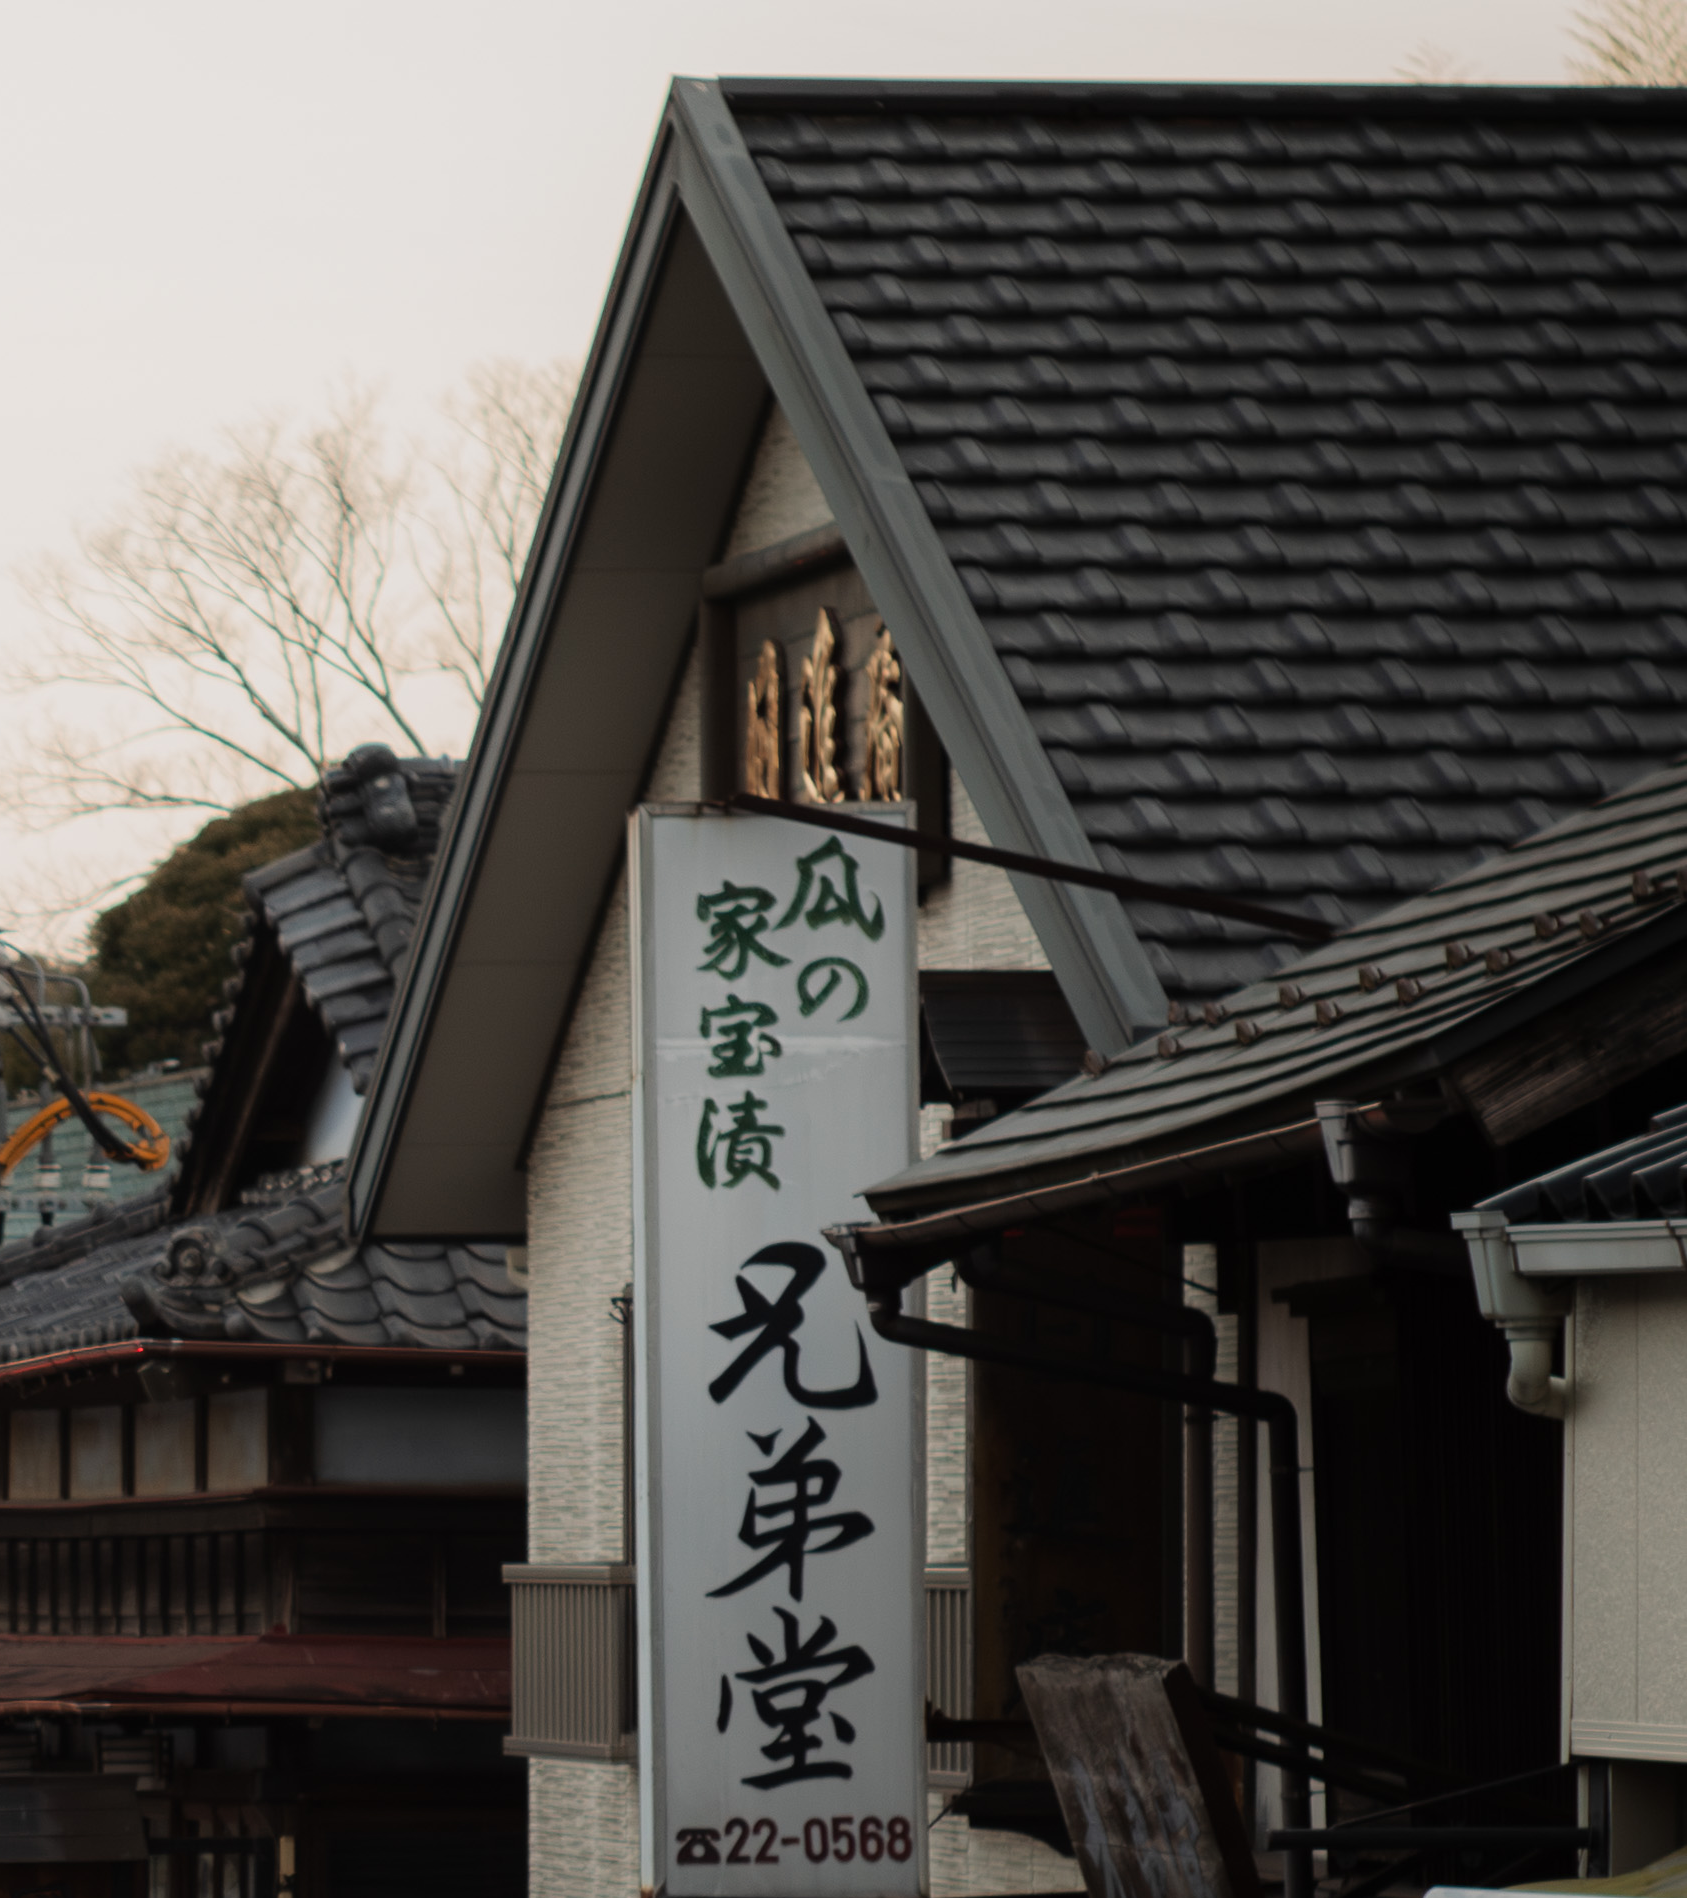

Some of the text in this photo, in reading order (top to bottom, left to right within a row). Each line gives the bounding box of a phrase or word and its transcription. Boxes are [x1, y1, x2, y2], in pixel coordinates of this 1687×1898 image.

[696, 879, 790, 1193] 家宝漬
[775, 831, 887, 1025] 瓜の
[706, 1238, 880, 1793] 兄弟堂
[723, 1815, 914, 1867] 22-0568
